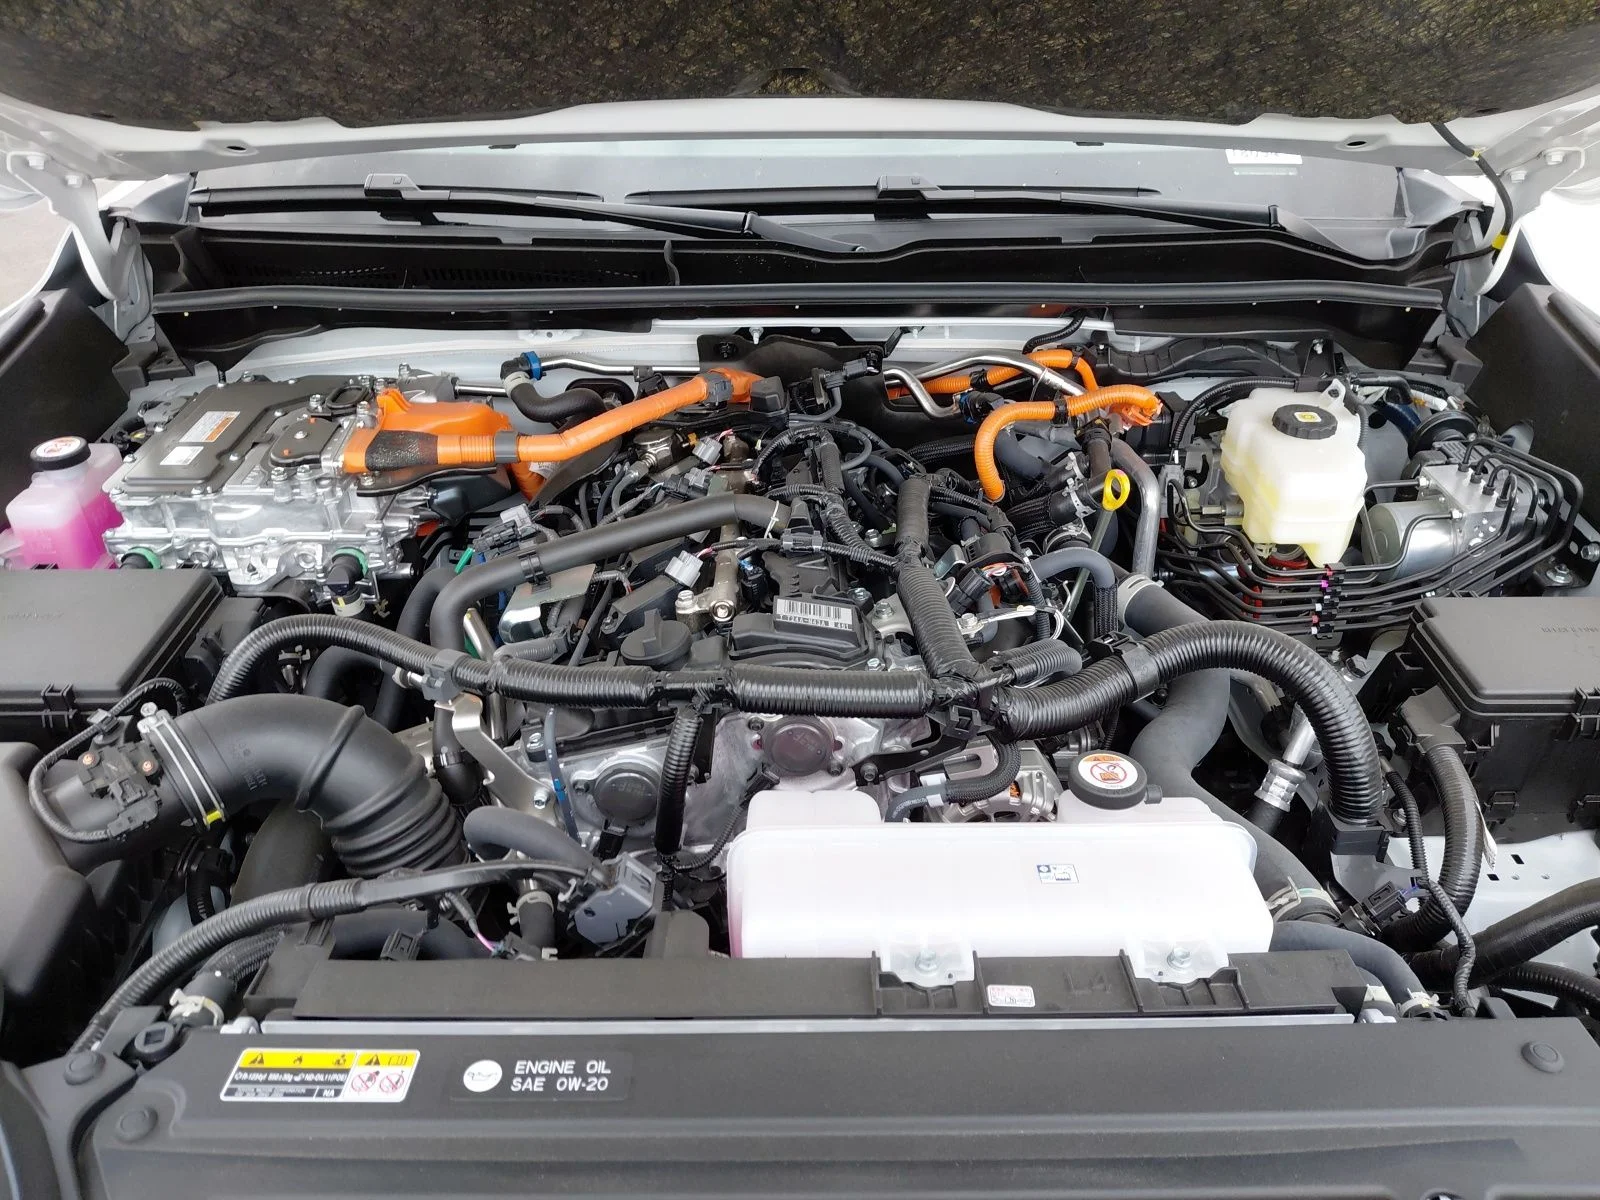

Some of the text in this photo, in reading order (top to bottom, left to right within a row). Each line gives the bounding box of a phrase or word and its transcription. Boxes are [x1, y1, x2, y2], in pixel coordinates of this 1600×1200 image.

[514, 1060, 611, 1074] ENGINE OIL
[510, 1076, 546, 1091] SAE
[322, 1089, 335, 1097] NA
